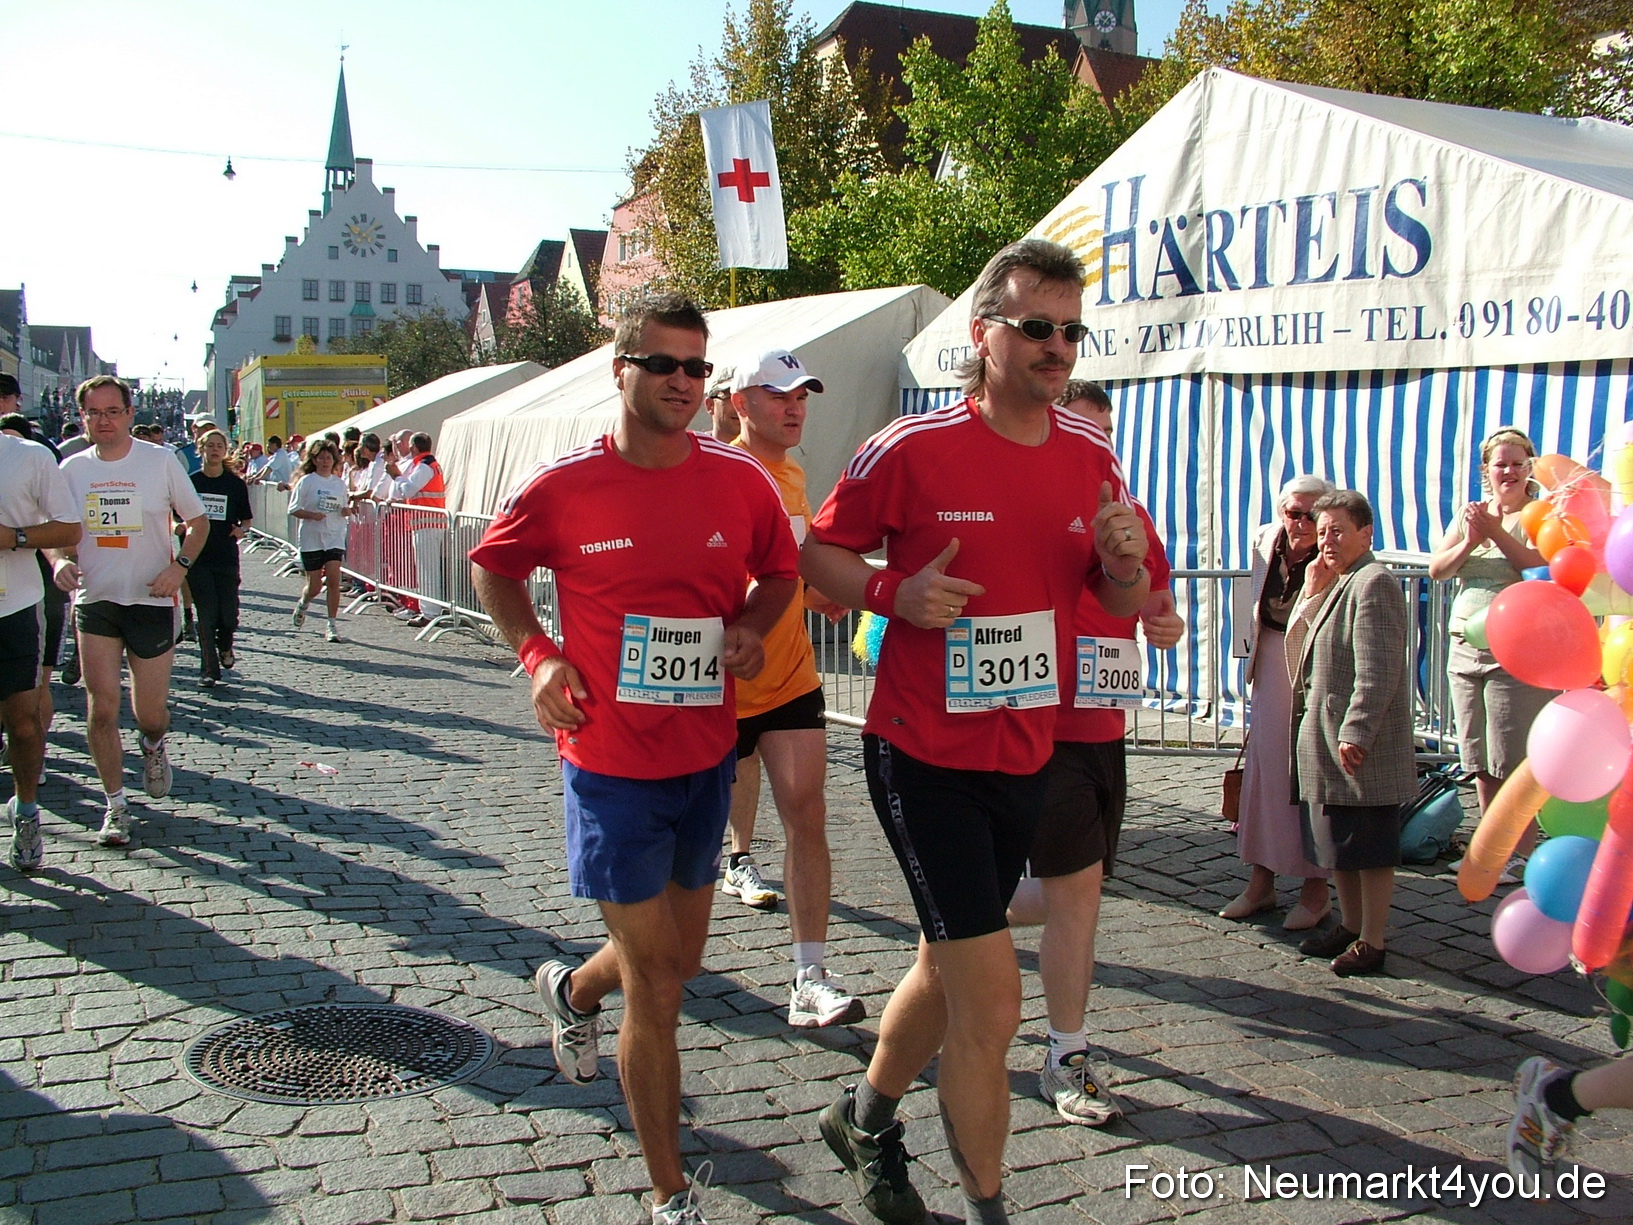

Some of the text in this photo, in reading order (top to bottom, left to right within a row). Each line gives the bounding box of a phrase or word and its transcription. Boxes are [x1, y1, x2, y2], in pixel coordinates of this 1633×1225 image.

[1095, 173, 1433, 306] HÄRTEIS
[1361, 304, 1448, 342] TEL.
[1459, 289, 1633, 339] 09180-40
[777, 354, 800, 369] W
[90, 480, 136, 489] SportScheck
[99, 497, 131, 506] Thomas
[101, 511, 118, 525] 21
[936, 511, 995, 522] TOSHIBA
[579, 538, 634, 555] TOSHIBA
[650, 626, 702, 646] Jürgen
[974, 625, 1023, 646] Alfred
[628, 647, 640, 662] D
[1097, 645, 1120, 659] Tom
[953, 653, 965, 668] D
[650, 655, 720, 682] 3014
[978, 652, 1050, 687] 3013
[1082, 662, 1091, 675] D
[1097, 668, 1140, 690] 3008
[1017, 690, 1058, 702] PFLEIDERER
